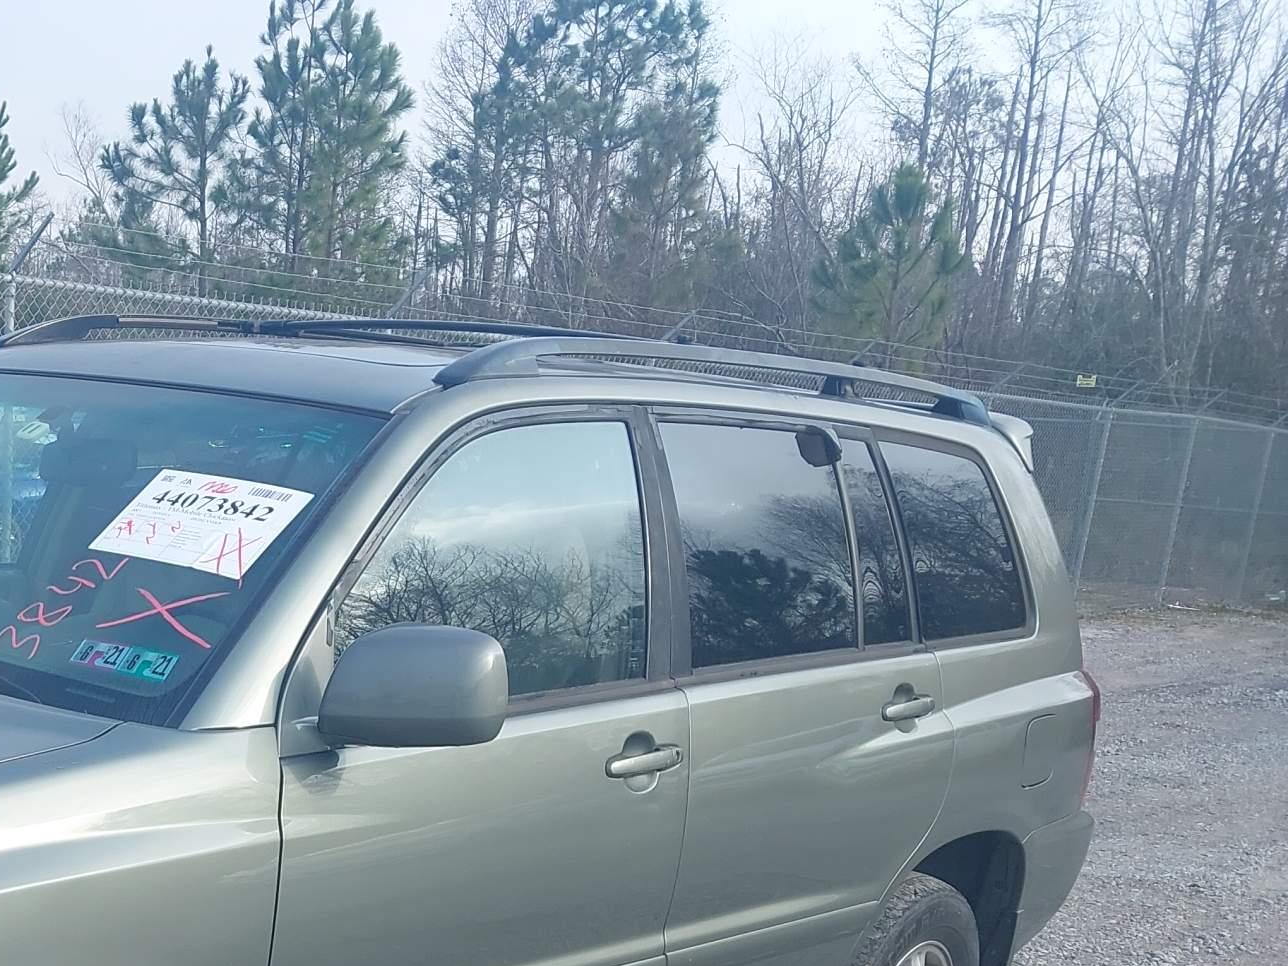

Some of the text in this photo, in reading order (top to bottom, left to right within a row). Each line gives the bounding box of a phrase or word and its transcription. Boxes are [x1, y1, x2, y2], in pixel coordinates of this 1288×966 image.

[152, 490, 275, 522] 44073842
[103, 645, 125, 665] 21
[127, 654, 173, 676] 6 21
